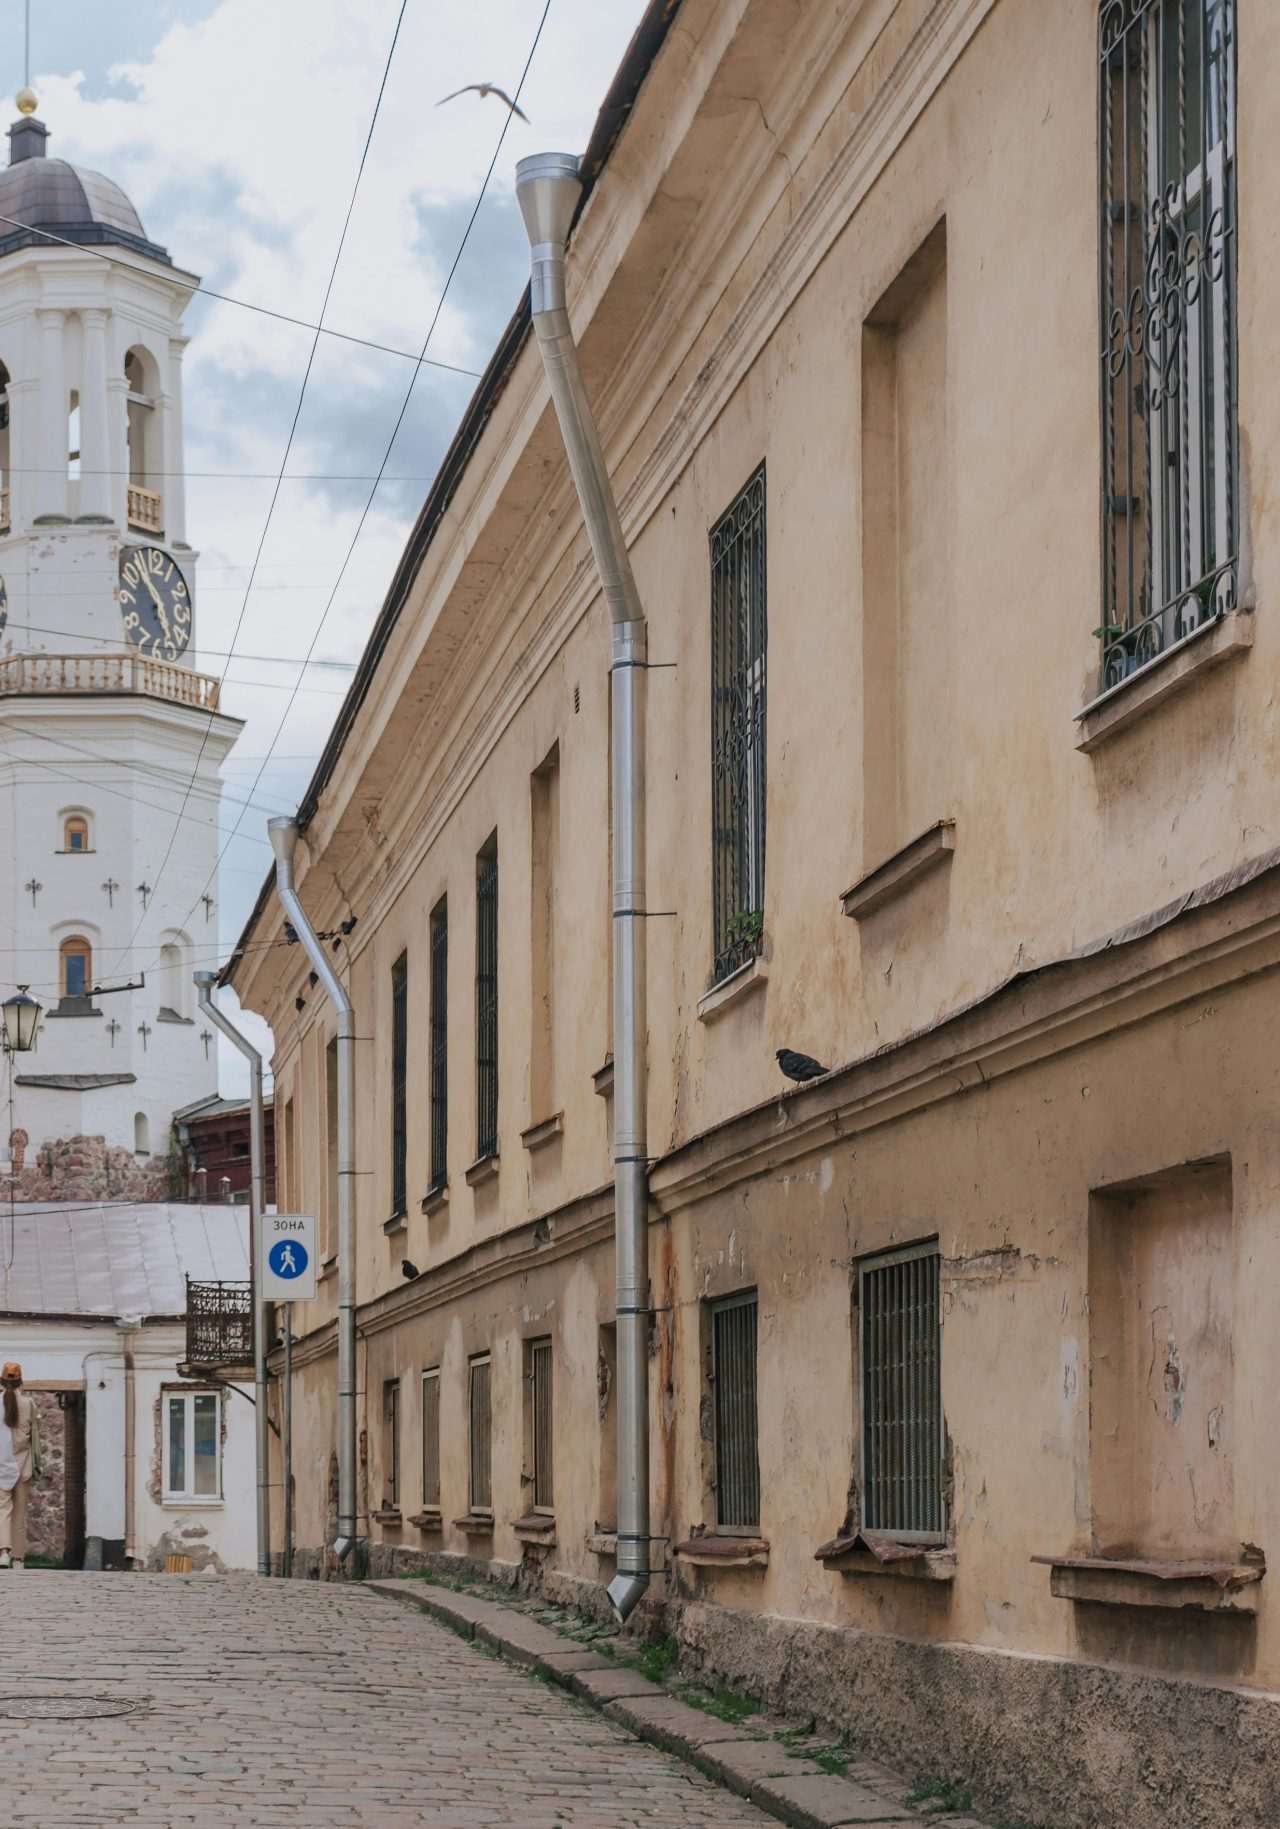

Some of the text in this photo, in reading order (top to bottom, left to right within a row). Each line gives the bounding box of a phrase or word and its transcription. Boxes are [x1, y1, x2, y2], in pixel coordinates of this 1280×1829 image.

[148, 548, 164, 576] 12
[122, 563, 139, 589] 10
[119, 590, 136, 604] 9
[172, 582, 186, 600] 2
[124, 611, 139, 630] 8
[174, 604, 190, 623] 3
[139, 626, 151, 651] 7
[173, 624, 188, 646] 4
[274, 1221, 304, 1230] ЗОНА
